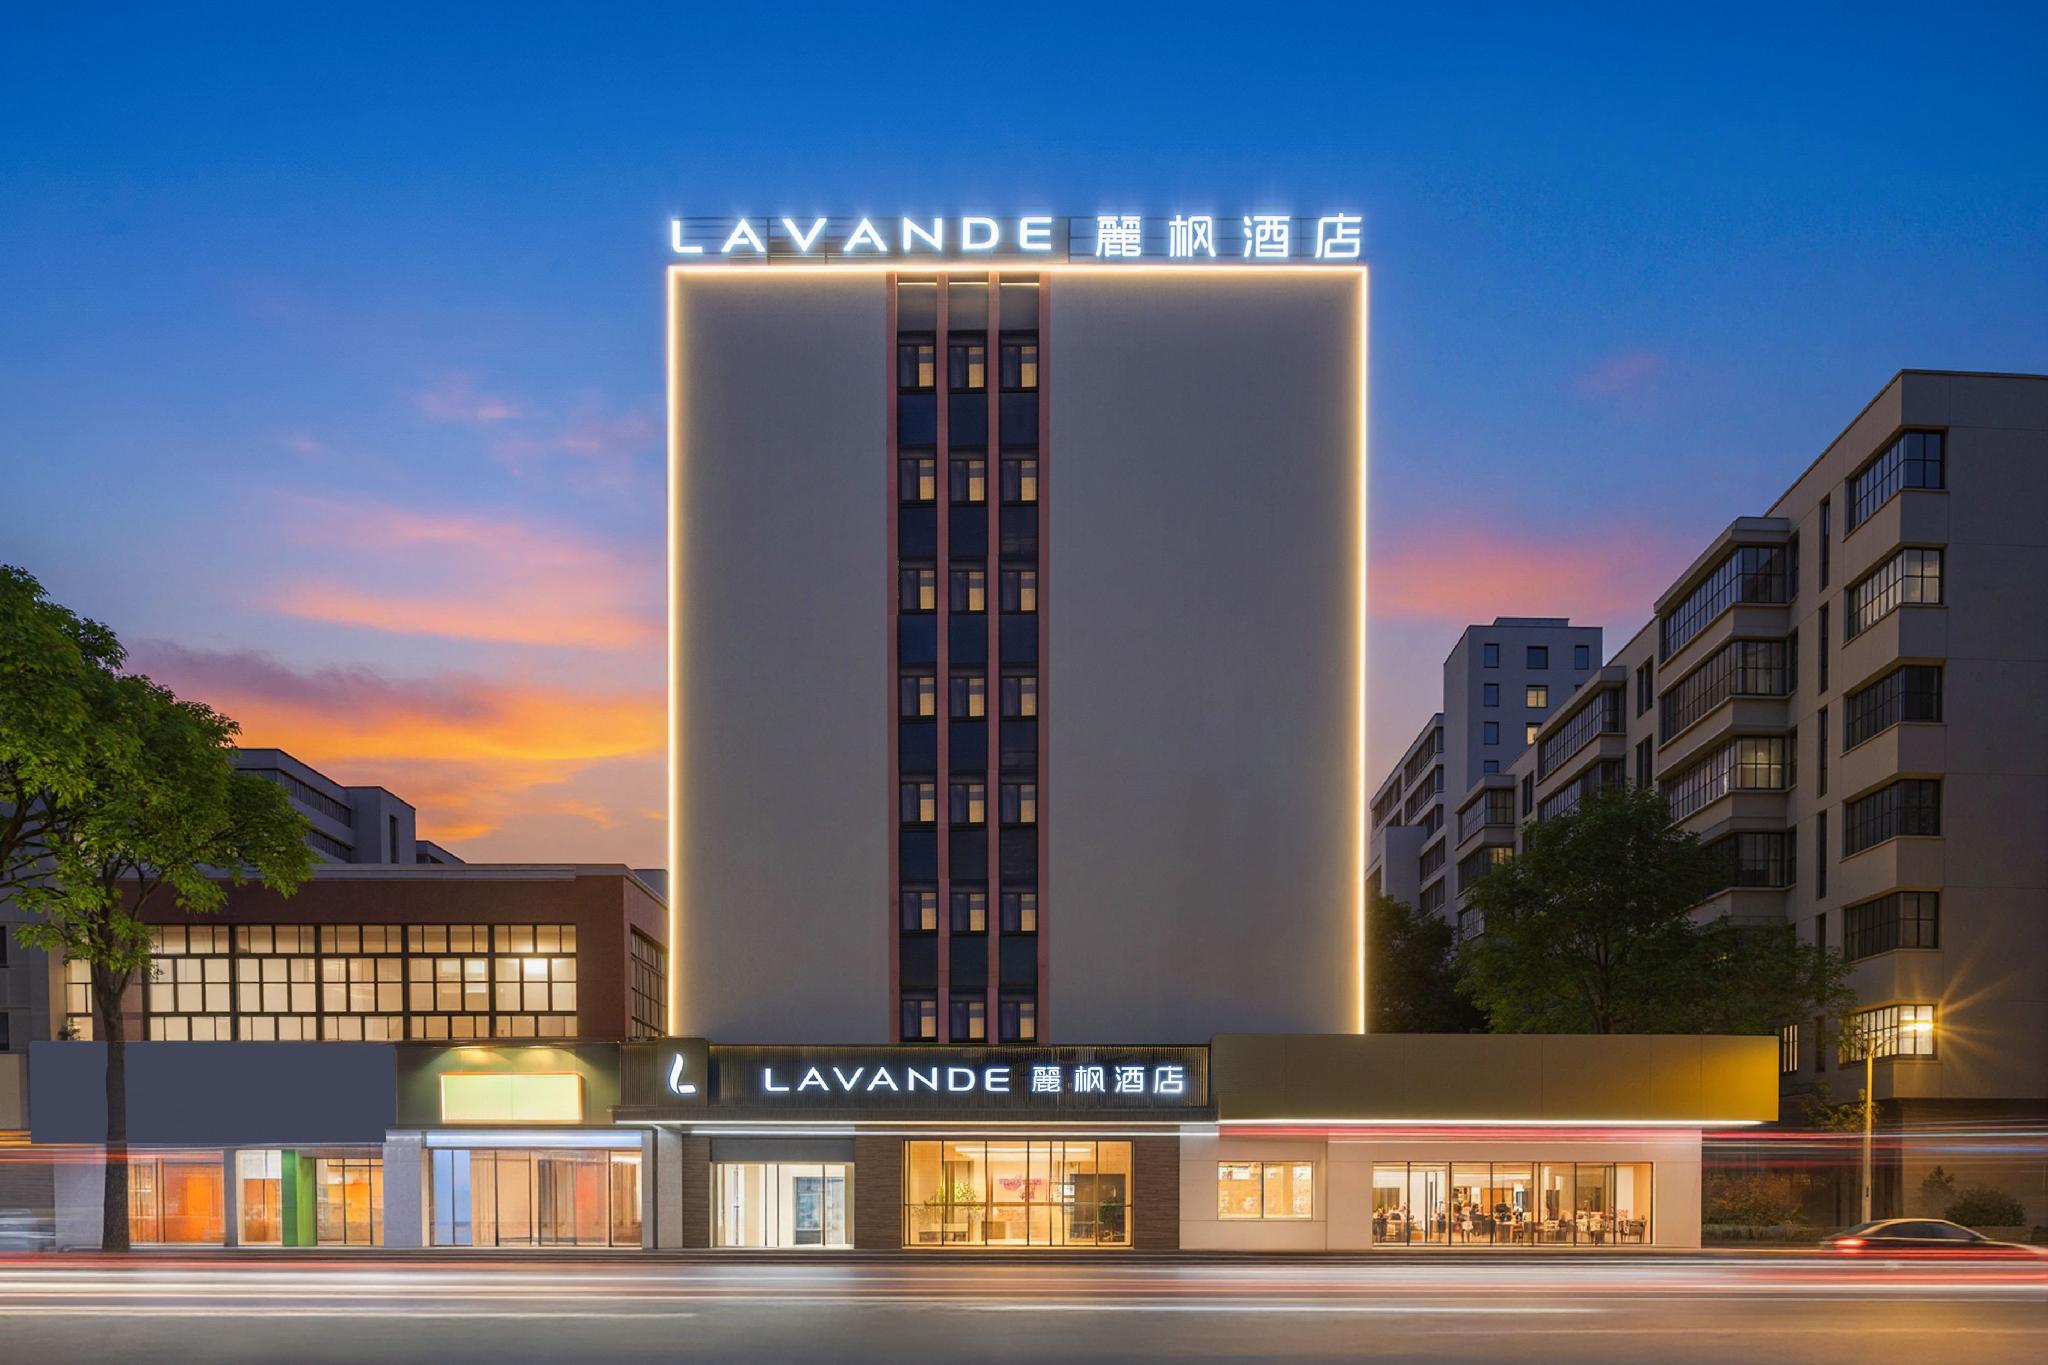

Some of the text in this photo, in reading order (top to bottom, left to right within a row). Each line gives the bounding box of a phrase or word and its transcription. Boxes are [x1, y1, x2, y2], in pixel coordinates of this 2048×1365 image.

[671, 213, 1362, 258] LAVANDE 麗枫酒店
[764, 1065, 1183, 1093] LAVANDE 麗枫酒店
